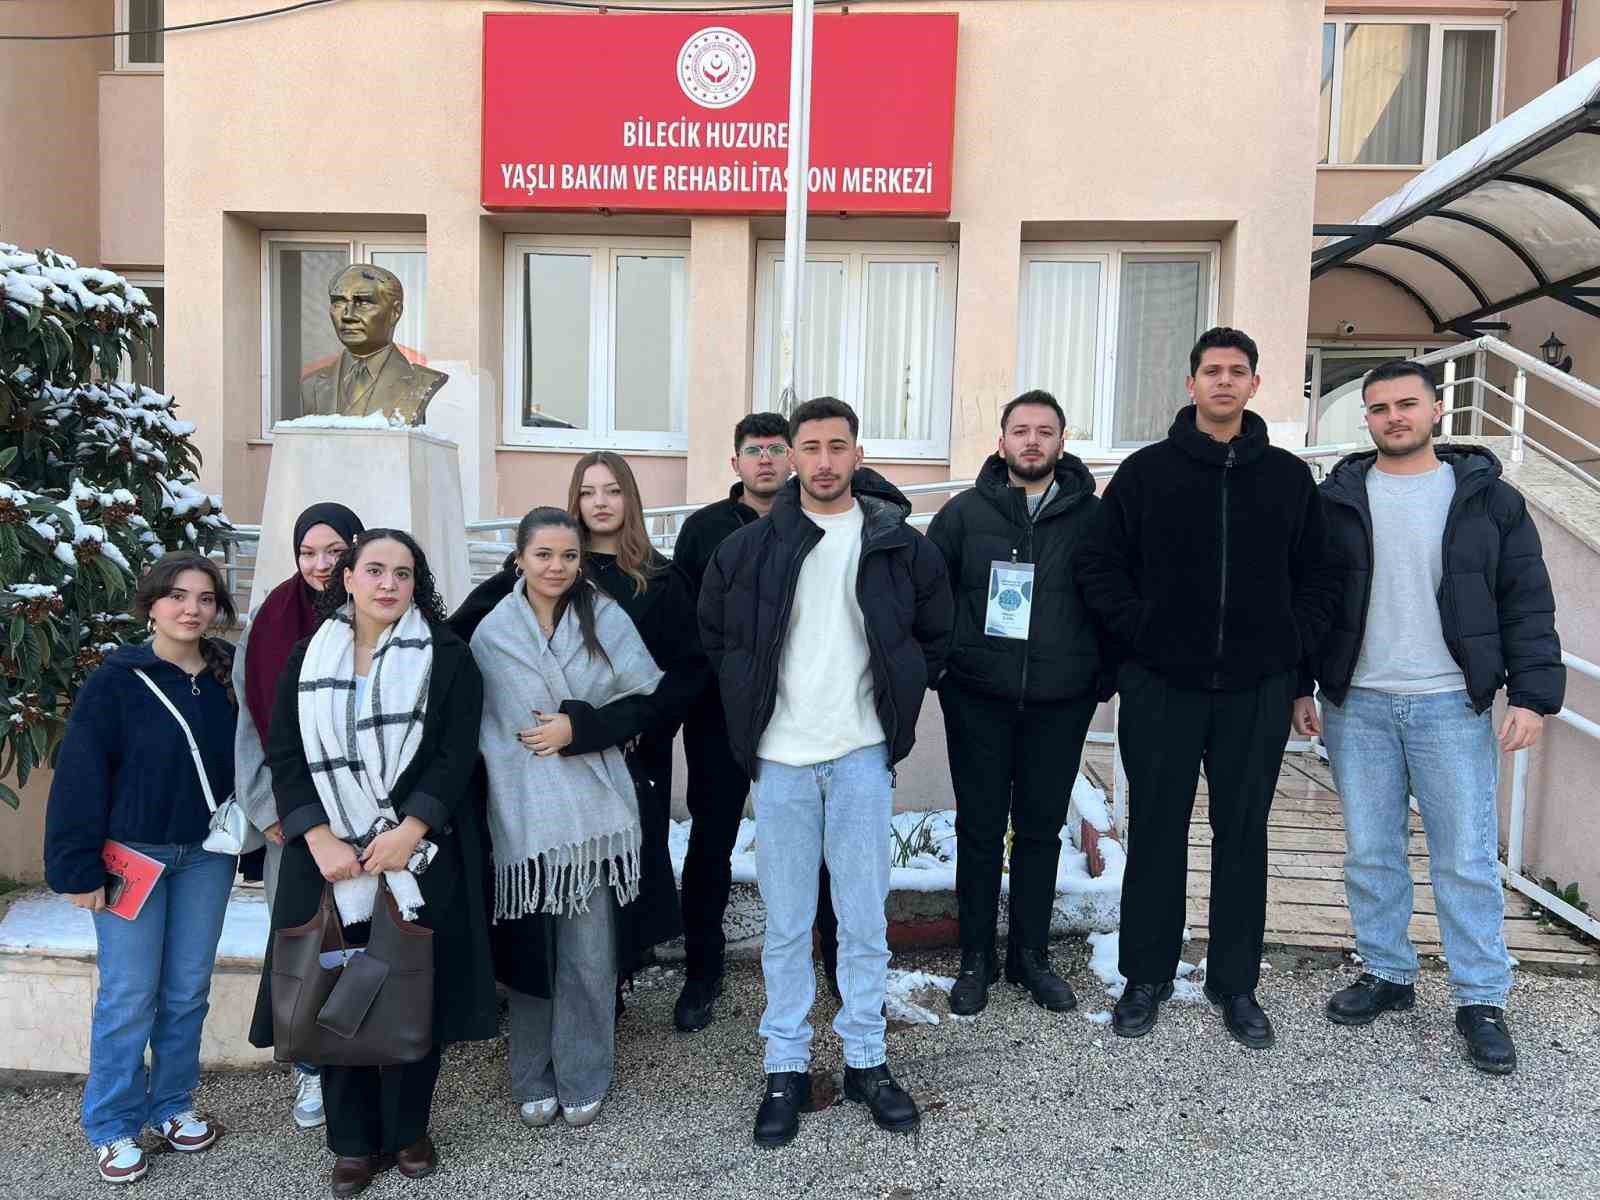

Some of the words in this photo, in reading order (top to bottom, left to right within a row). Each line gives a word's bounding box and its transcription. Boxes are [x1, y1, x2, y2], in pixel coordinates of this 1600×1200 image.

[623, 115, 701, 148] BİLECİK
[706, 122, 789, 149] HUZURE
[500, 163, 555, 196] YAŞLI
[561, 164, 628, 191] BAKIM
[632, 164, 658, 191] VE
[663, 160, 836, 193] REHABİLİTASON
[842, 161, 933, 193] MERKEZİ
